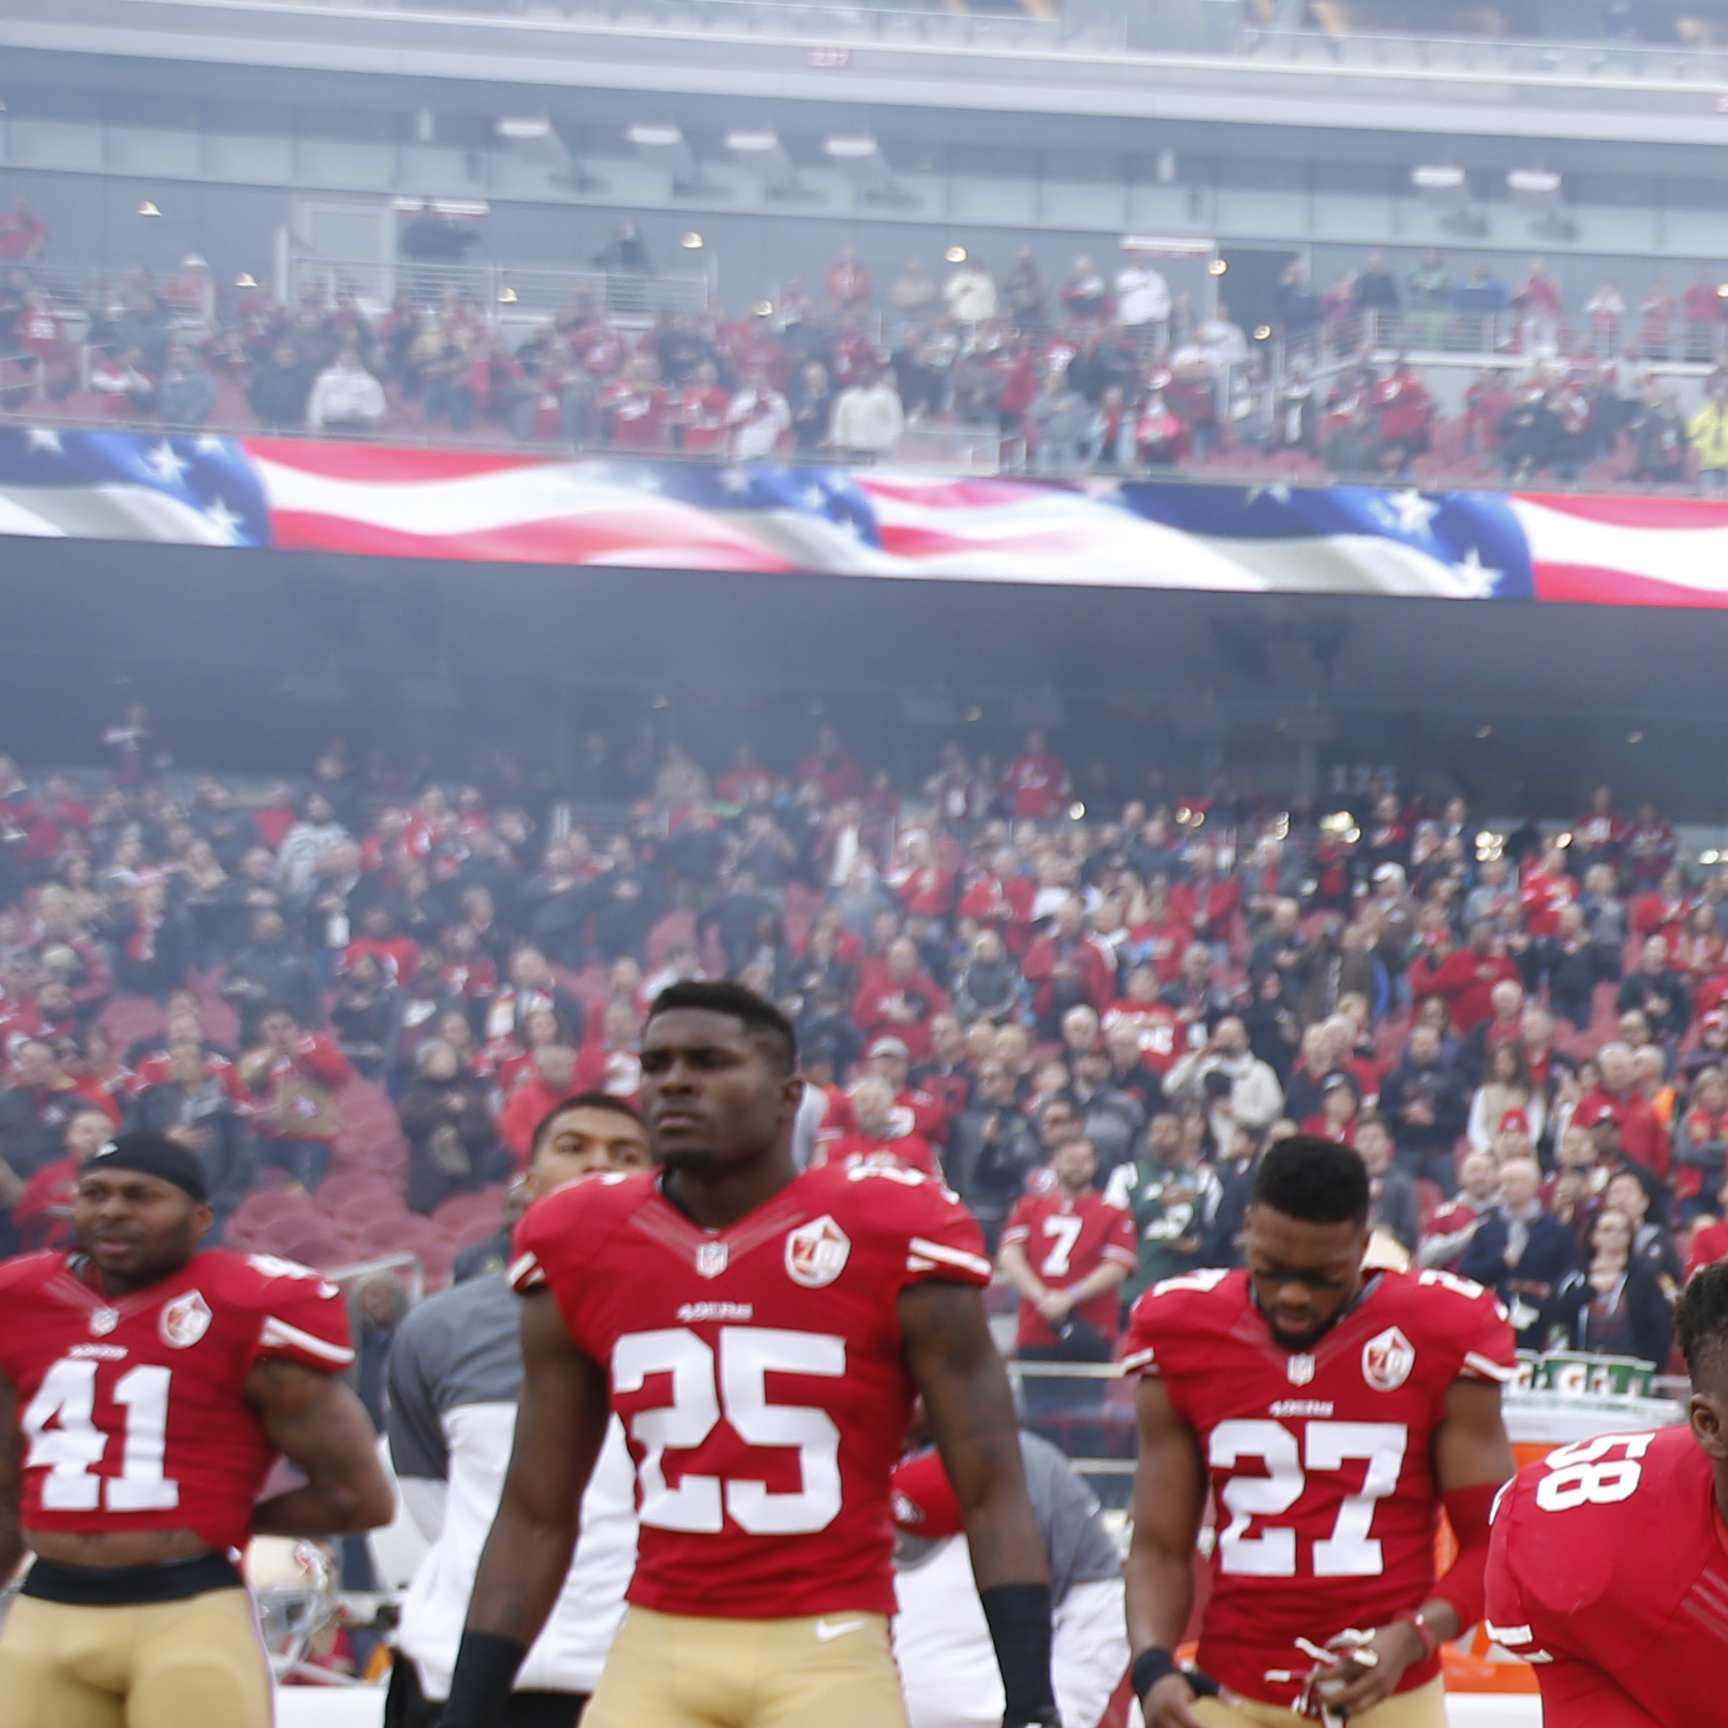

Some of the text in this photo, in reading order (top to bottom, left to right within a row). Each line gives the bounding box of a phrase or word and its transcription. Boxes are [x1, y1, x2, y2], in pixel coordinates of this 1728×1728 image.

[1042, 1214, 1083, 1276] 7
[21, 1357, 181, 1512] 41
[612, 1326, 846, 1535] 25
[1207, 1419, 1408, 1578] 27
